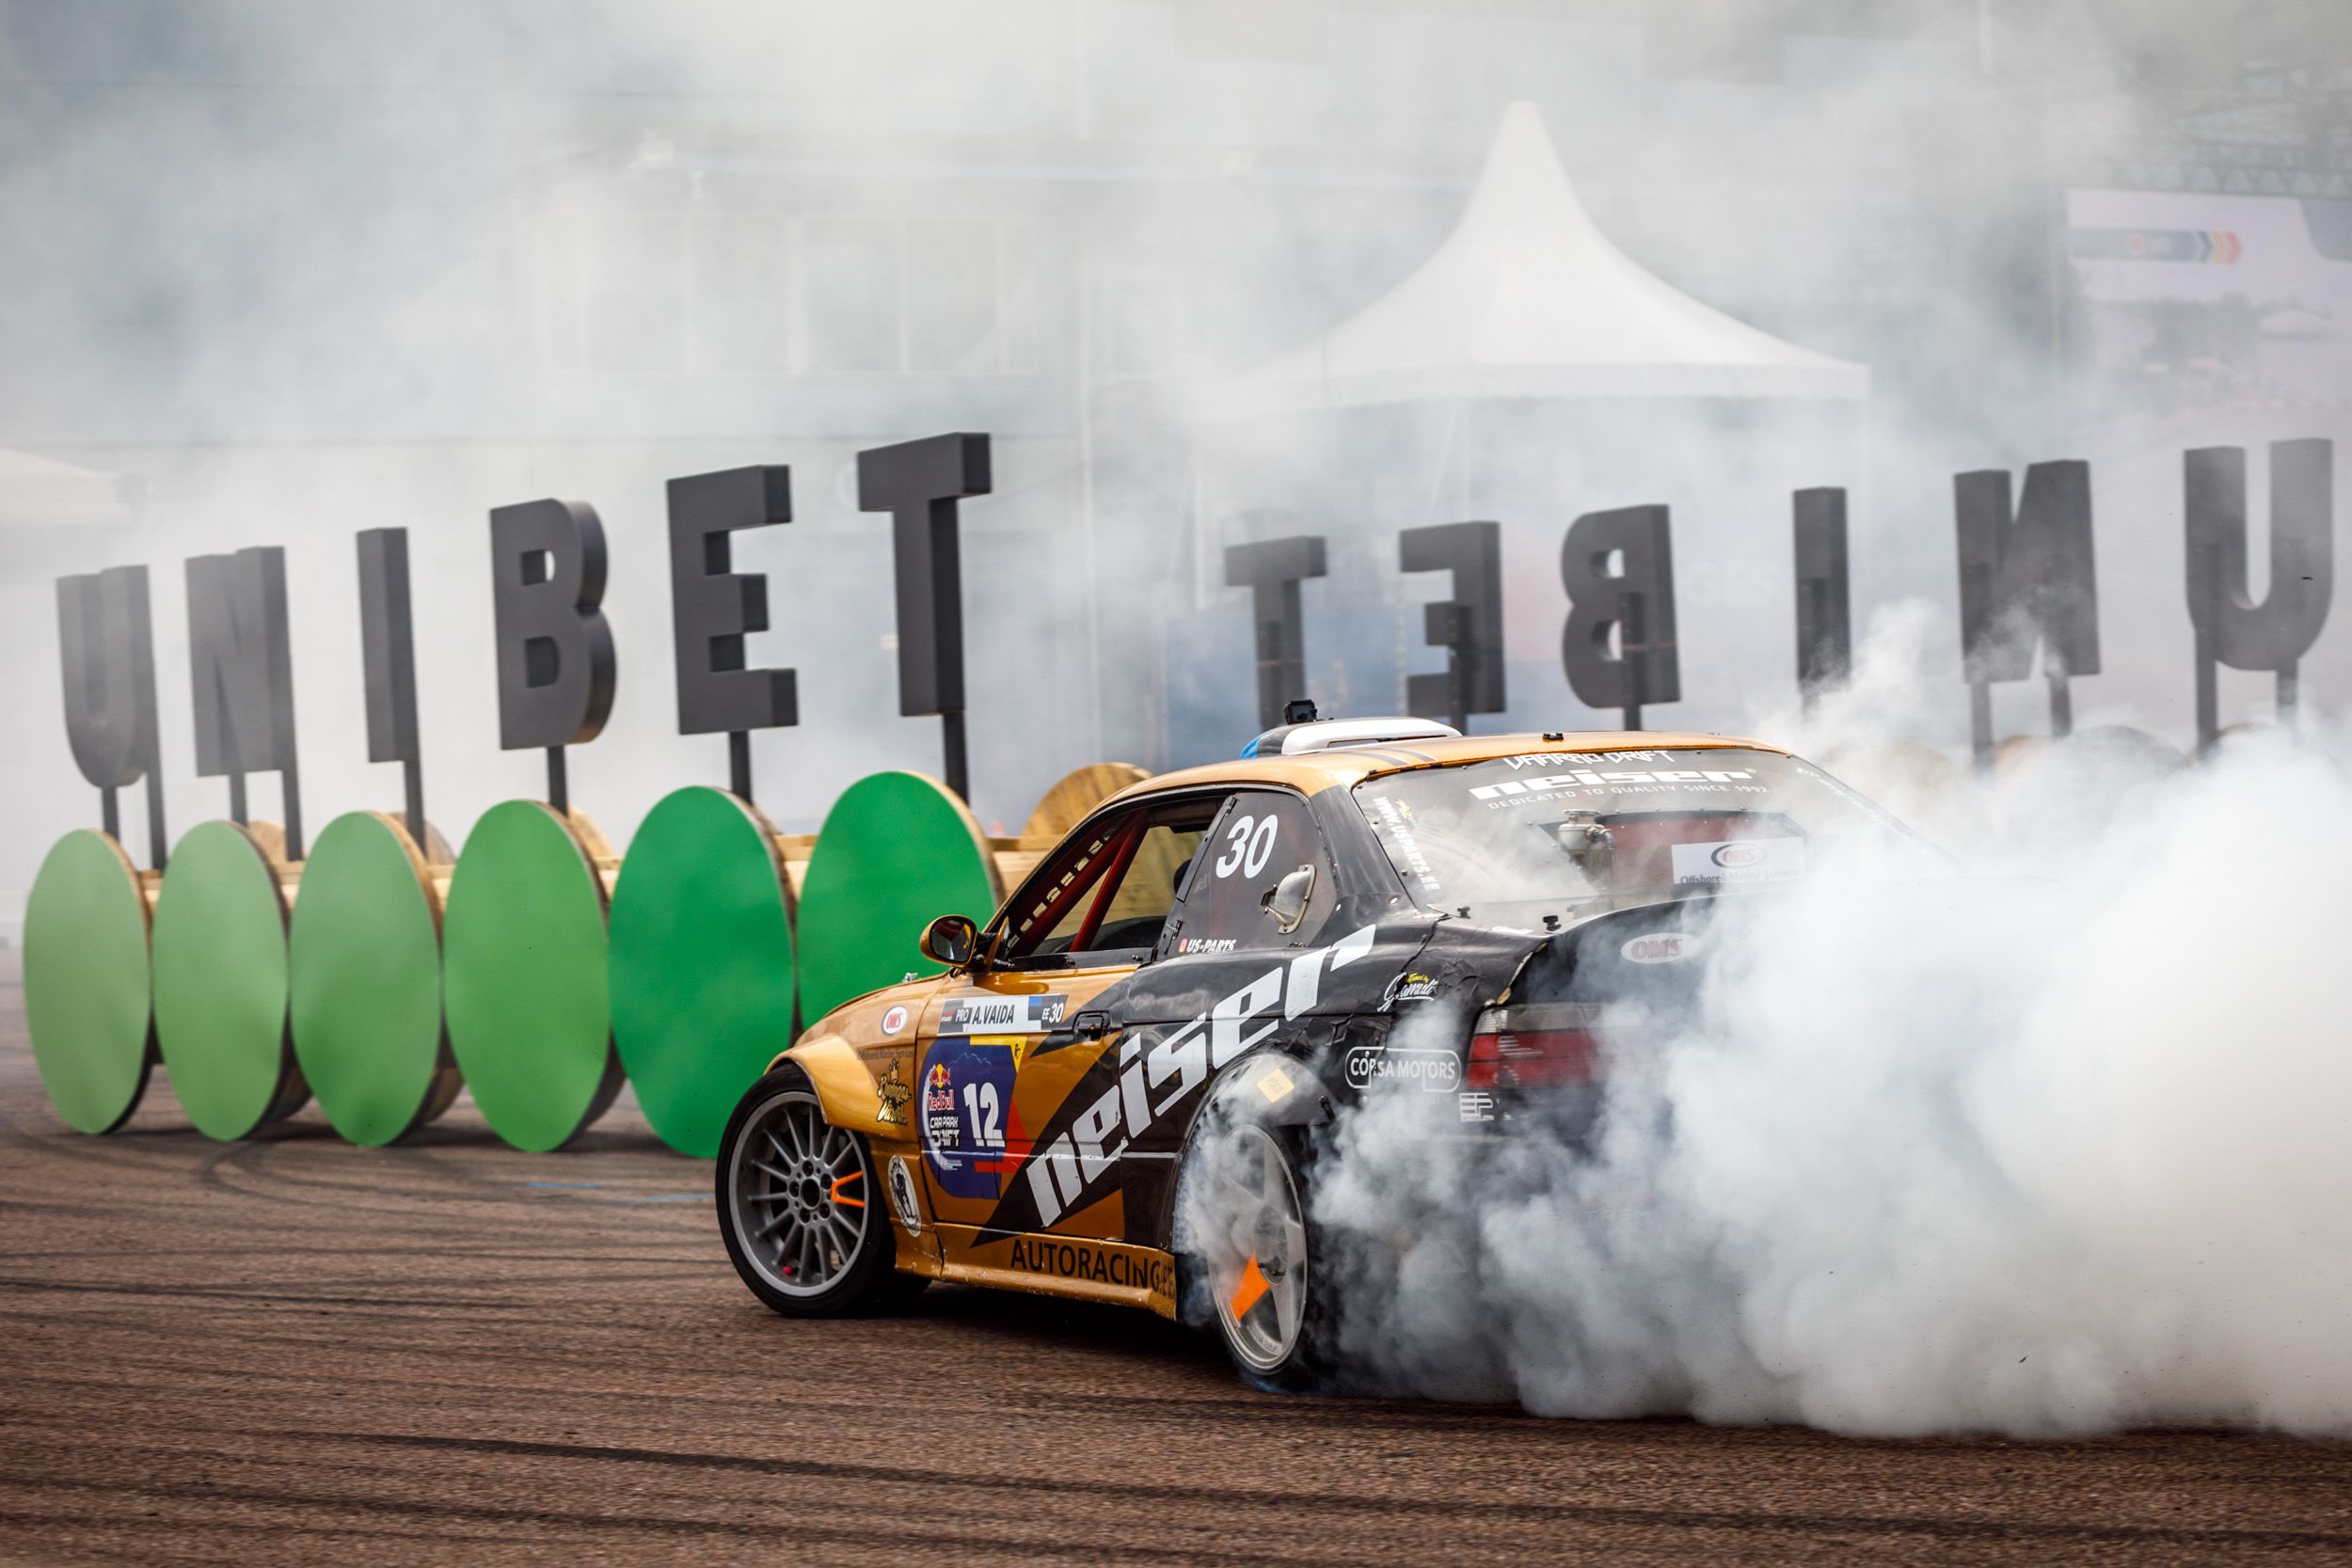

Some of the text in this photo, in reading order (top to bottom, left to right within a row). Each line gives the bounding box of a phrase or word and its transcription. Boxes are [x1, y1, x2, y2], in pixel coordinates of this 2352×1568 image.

[55, 432, 992, 788] UNIBET
[1487, 784, 1770, 810] DEDICATED TO QUALITY SINCE 1992
[1216, 815, 1279, 879] 30
[1186, 939, 1237, 953] US-PARTS
[955, 1003, 1064, 1025] PRO A.VAIDA EE 30
[1026, 924, 1376, 1227] neiser
[1350, 1057, 1456, 1081] CORSA MOTORS
[930, 1117, 959, 1129] CAR PARK
[963, 1082, 1006, 1148] 12
[930, 1130, 961, 1148] DRIFT
